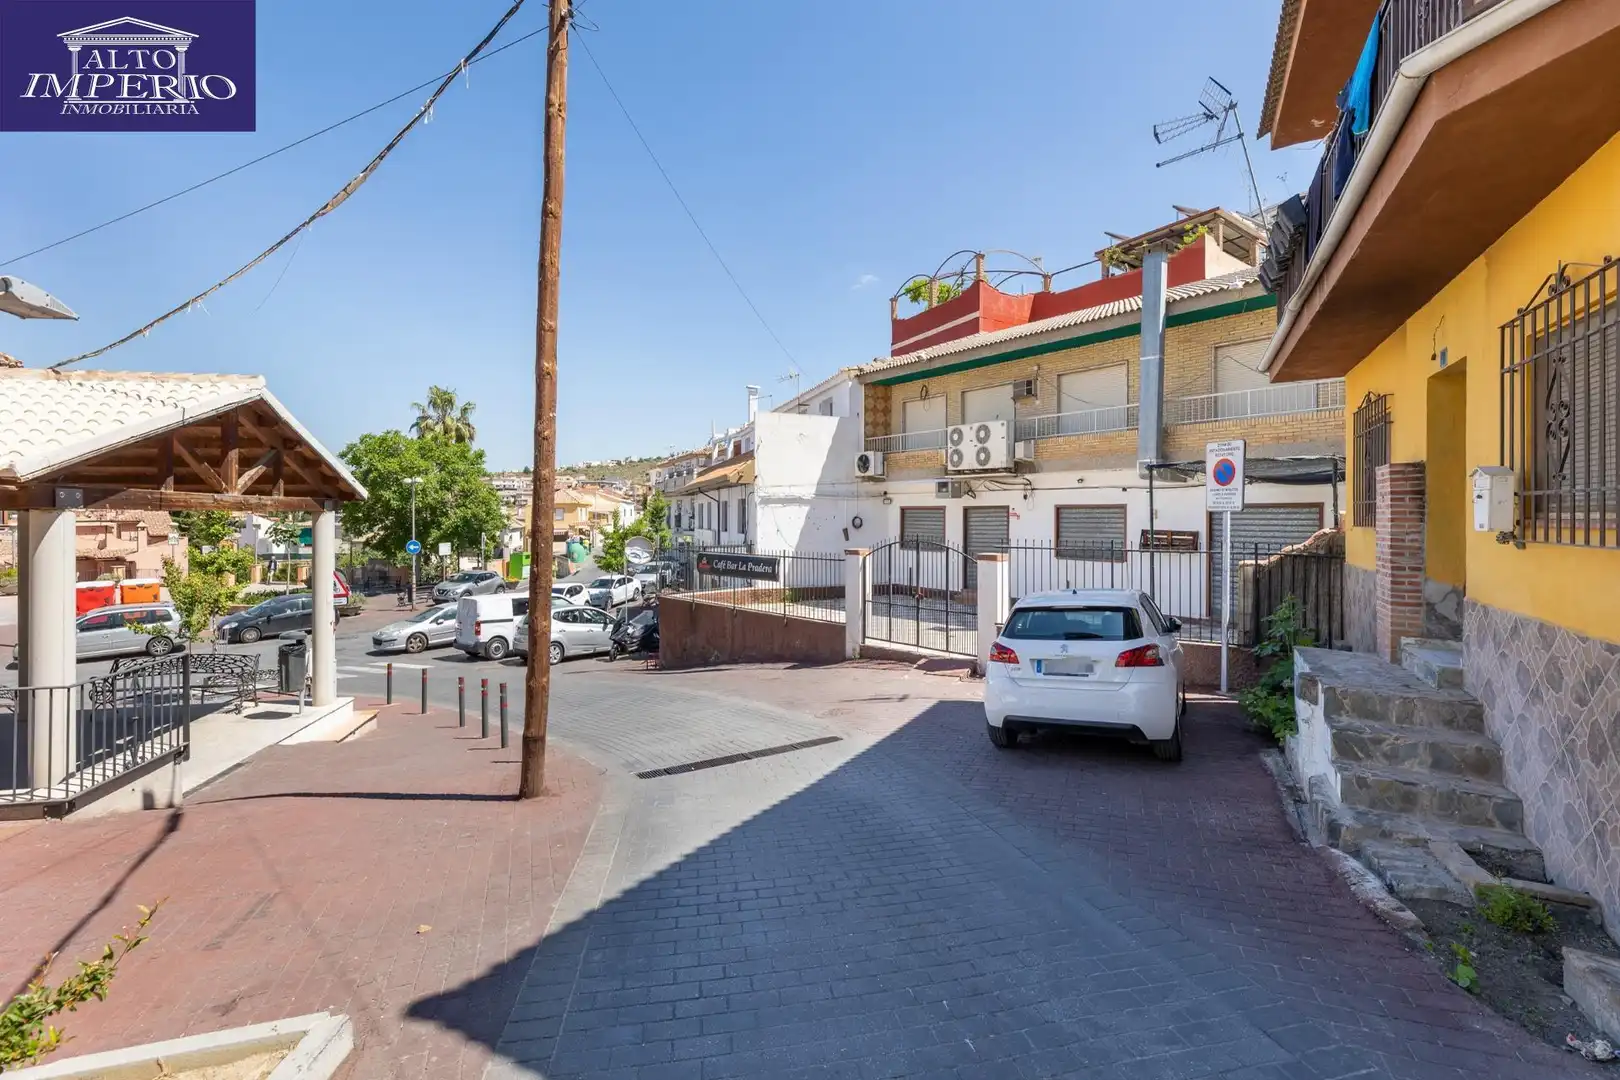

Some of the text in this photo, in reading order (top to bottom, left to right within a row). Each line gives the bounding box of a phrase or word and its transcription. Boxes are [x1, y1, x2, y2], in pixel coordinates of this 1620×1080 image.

[713, 559, 726, 570] Café
[726, 560, 738, 570] Bar
[739, 561, 746, 571] La
[747, 562, 773, 573] Pradera
